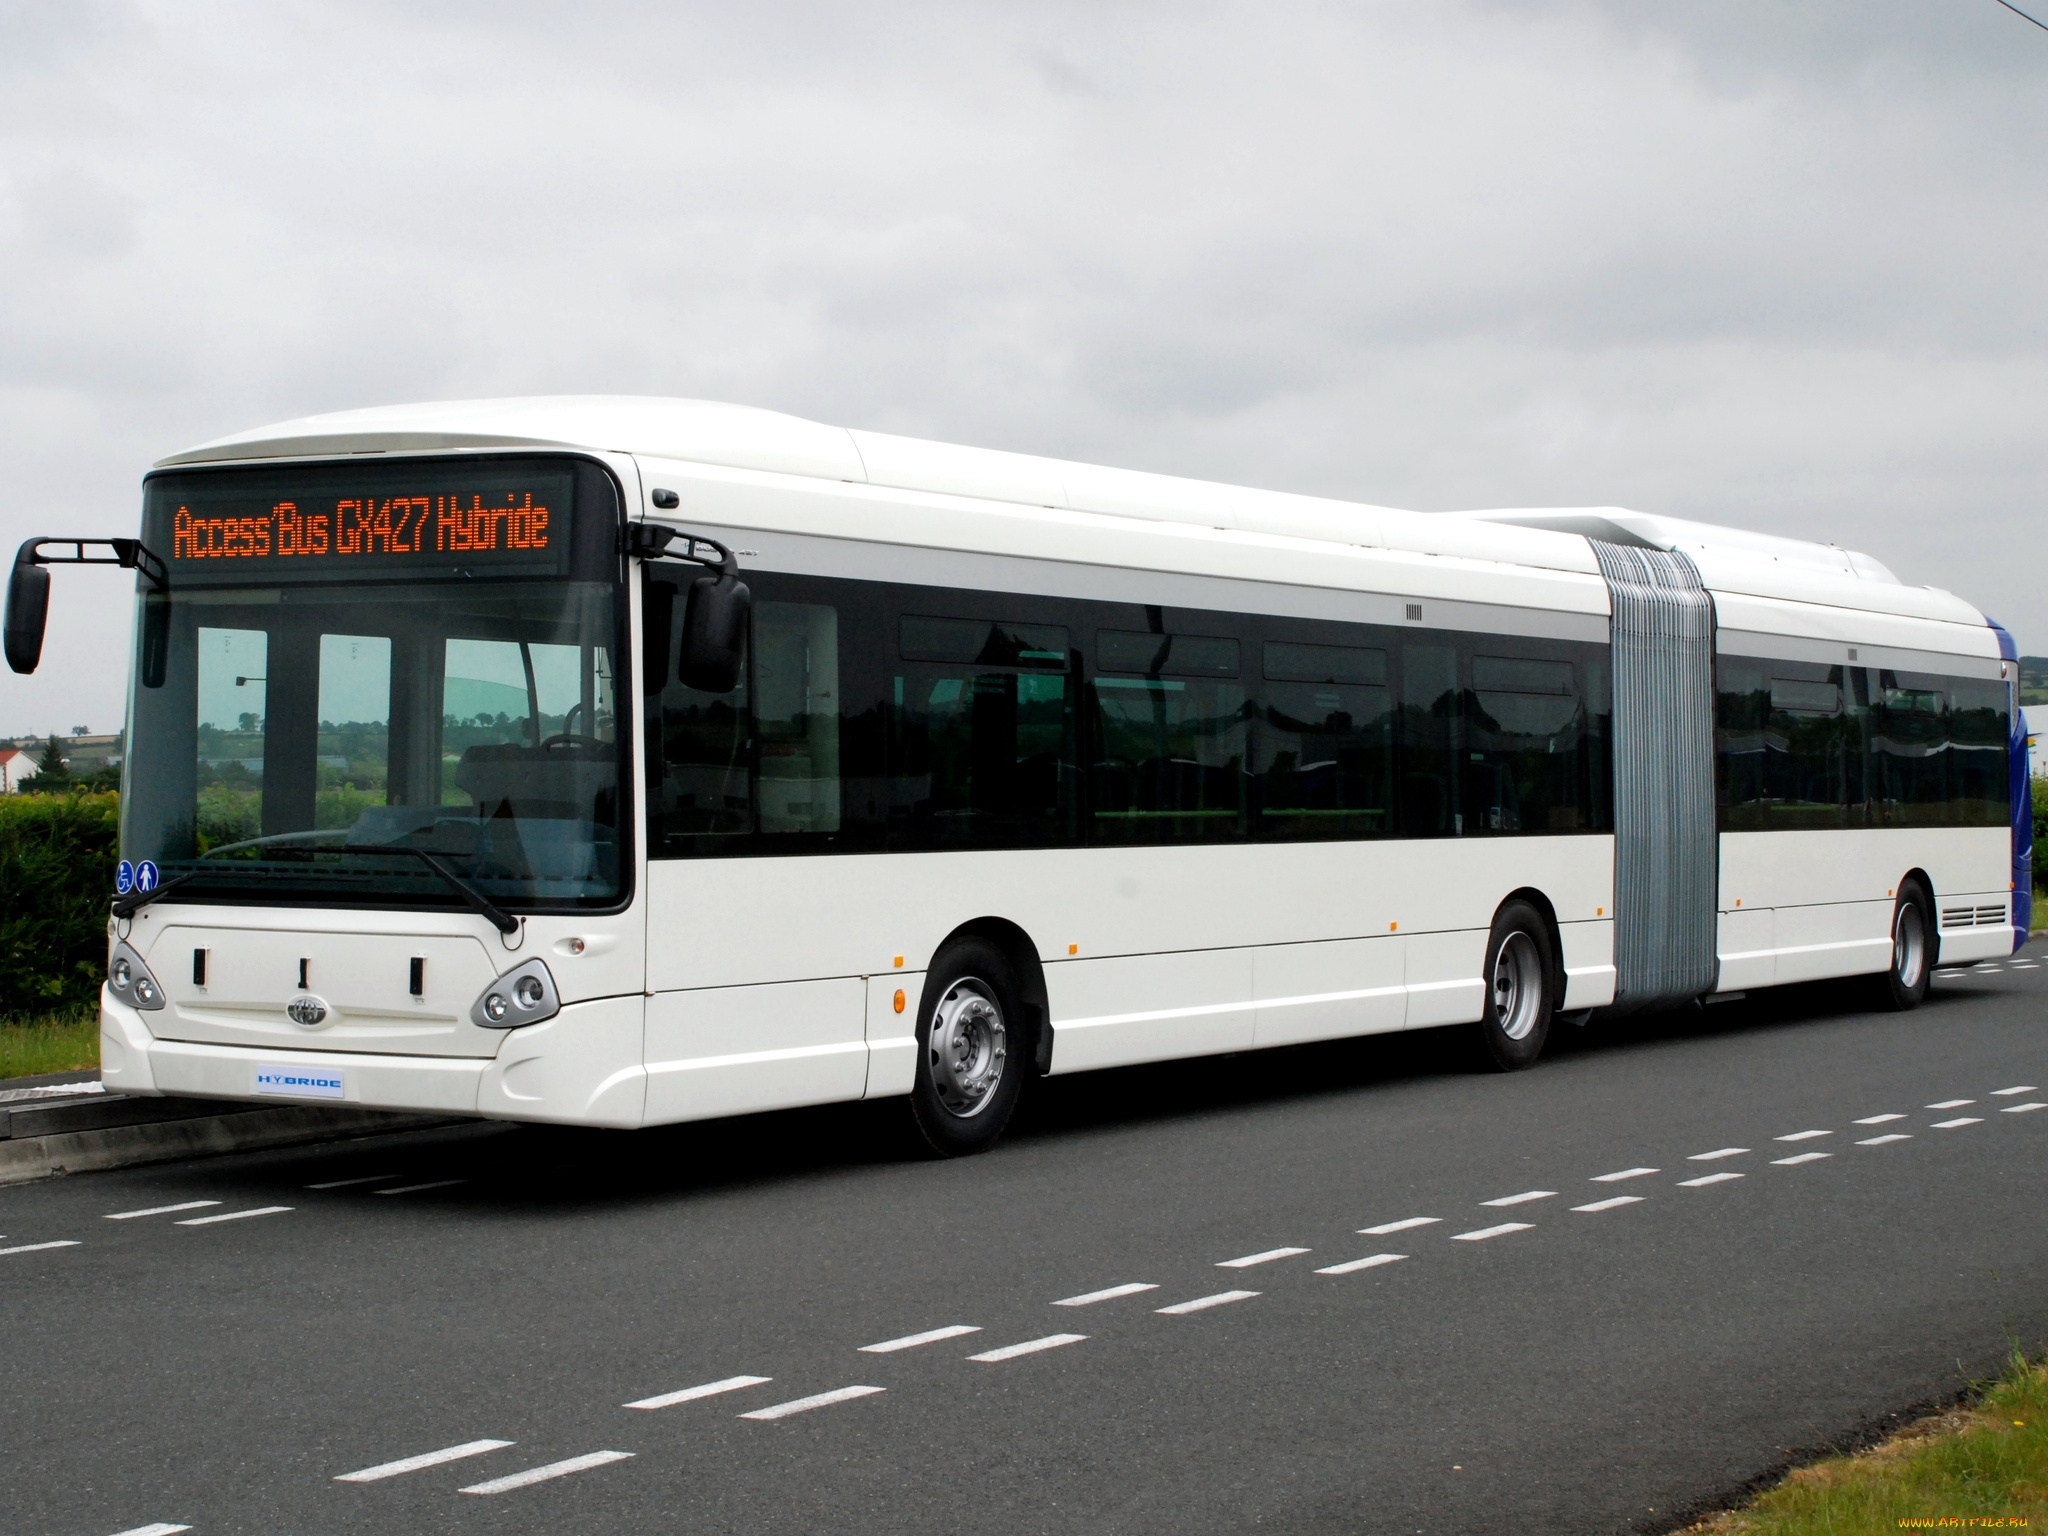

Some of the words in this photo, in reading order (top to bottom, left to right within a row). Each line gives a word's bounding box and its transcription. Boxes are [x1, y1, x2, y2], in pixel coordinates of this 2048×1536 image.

[174, 501, 328, 558] Access'Bus
[336, 497, 430, 554] GX427
[437, 493, 549, 551] Hybride
[258, 1075, 342, 1088] HYBRIDE
